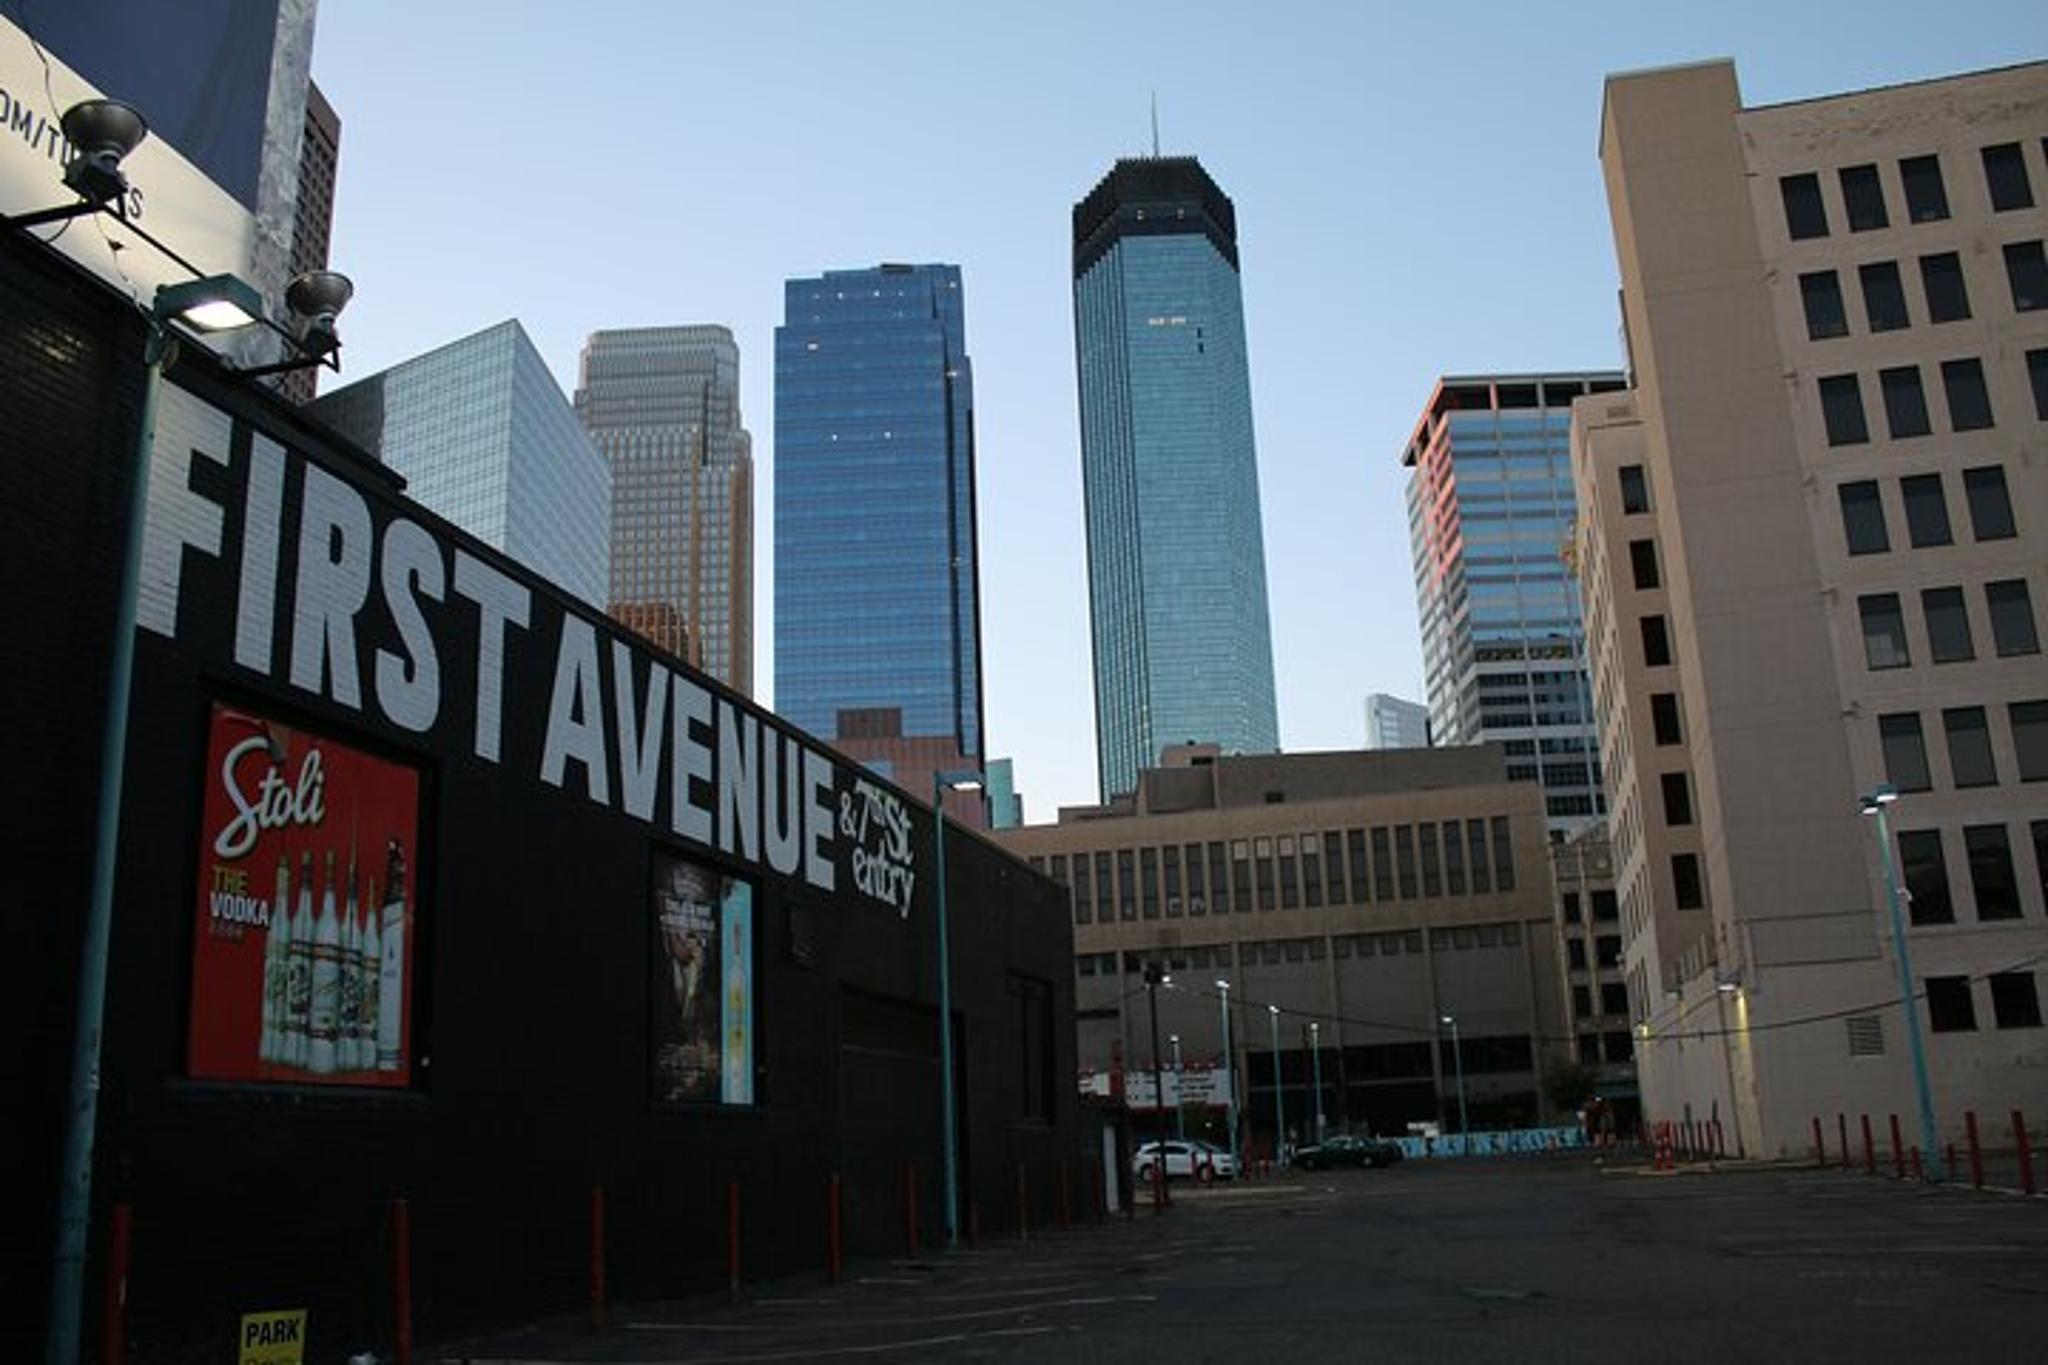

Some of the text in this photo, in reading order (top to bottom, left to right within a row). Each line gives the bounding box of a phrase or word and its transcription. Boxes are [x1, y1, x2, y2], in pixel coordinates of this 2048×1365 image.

[136, 377, 836, 891] FIRST AVENUE
[214, 735, 325, 858] Stoli
[840, 790, 857, 839] &
[212, 864, 248, 896] THE
[852, 838, 915, 919] entry
[210, 891, 269, 927] VODKA
[246, 1318, 300, 1349] PARK
